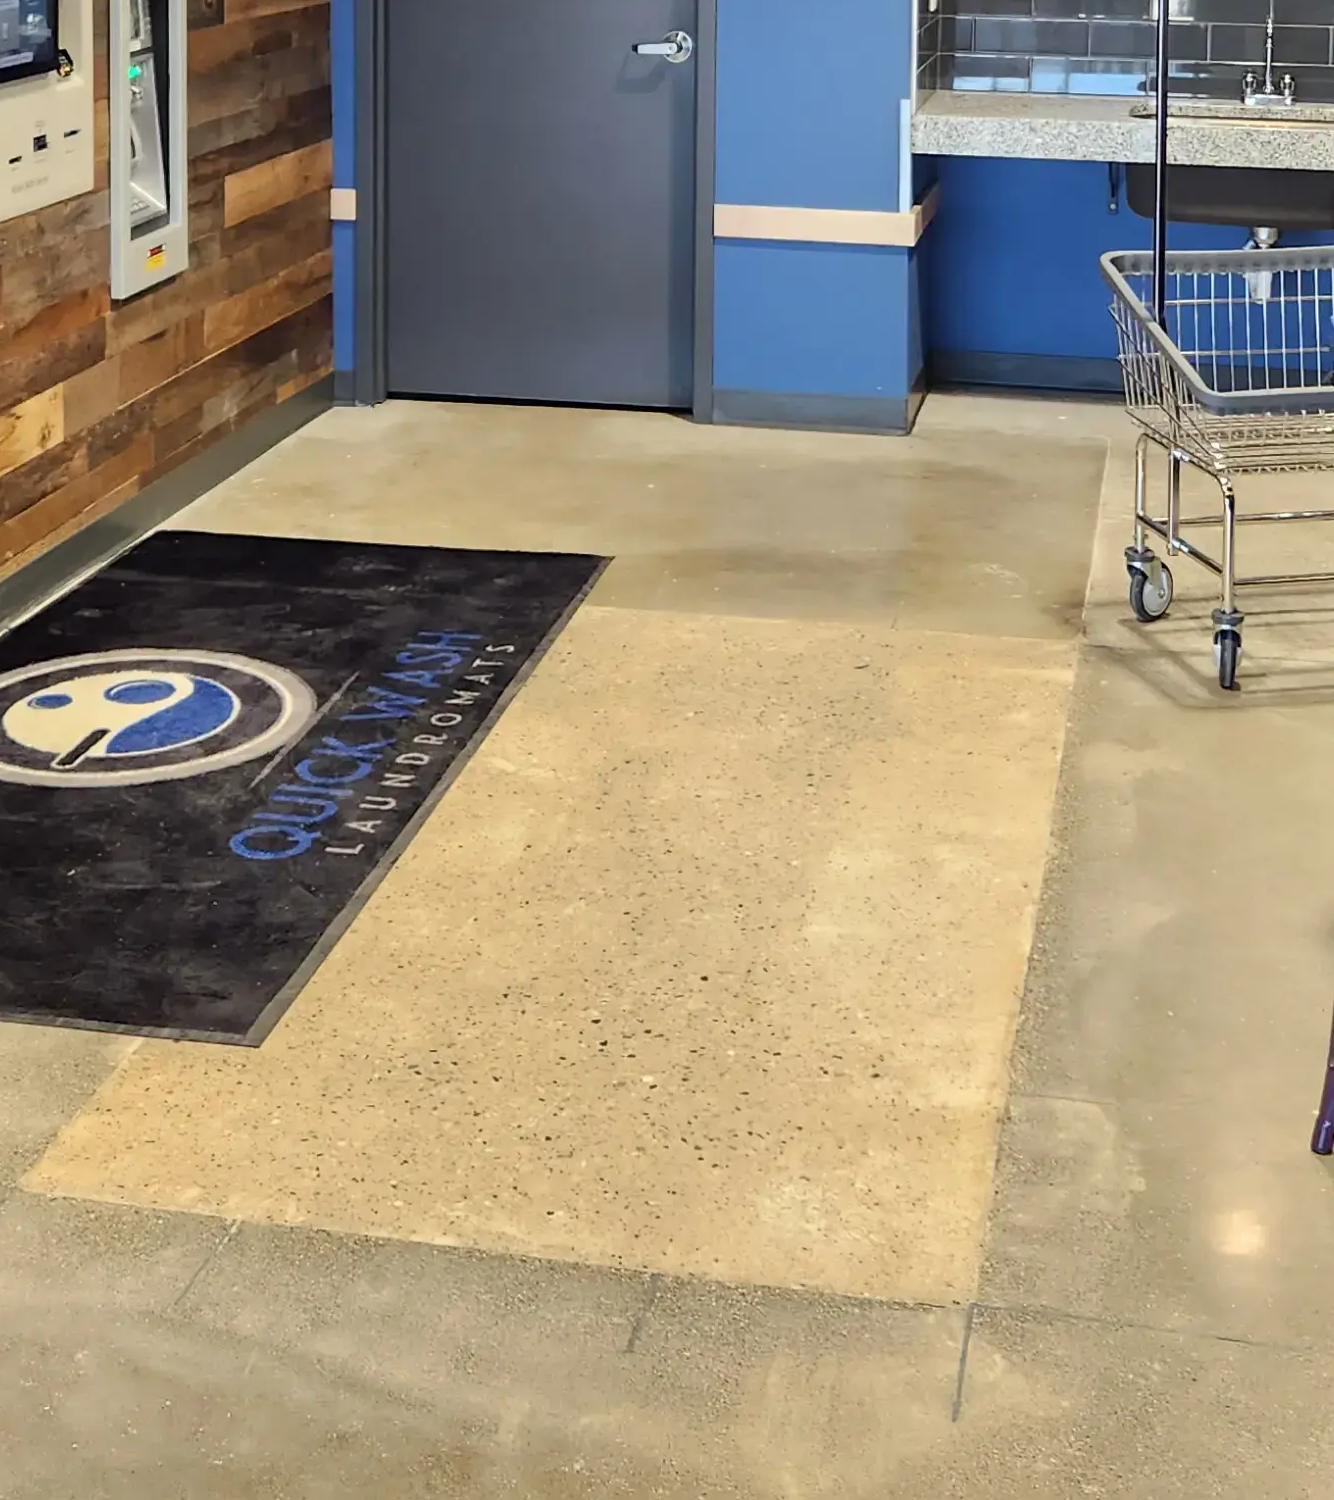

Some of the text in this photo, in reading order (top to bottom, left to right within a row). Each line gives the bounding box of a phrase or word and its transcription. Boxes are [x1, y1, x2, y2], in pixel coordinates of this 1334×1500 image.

[228, 630, 483, 860] QUICK WASH
[324, 643, 516, 856] LAUNDROMATS
